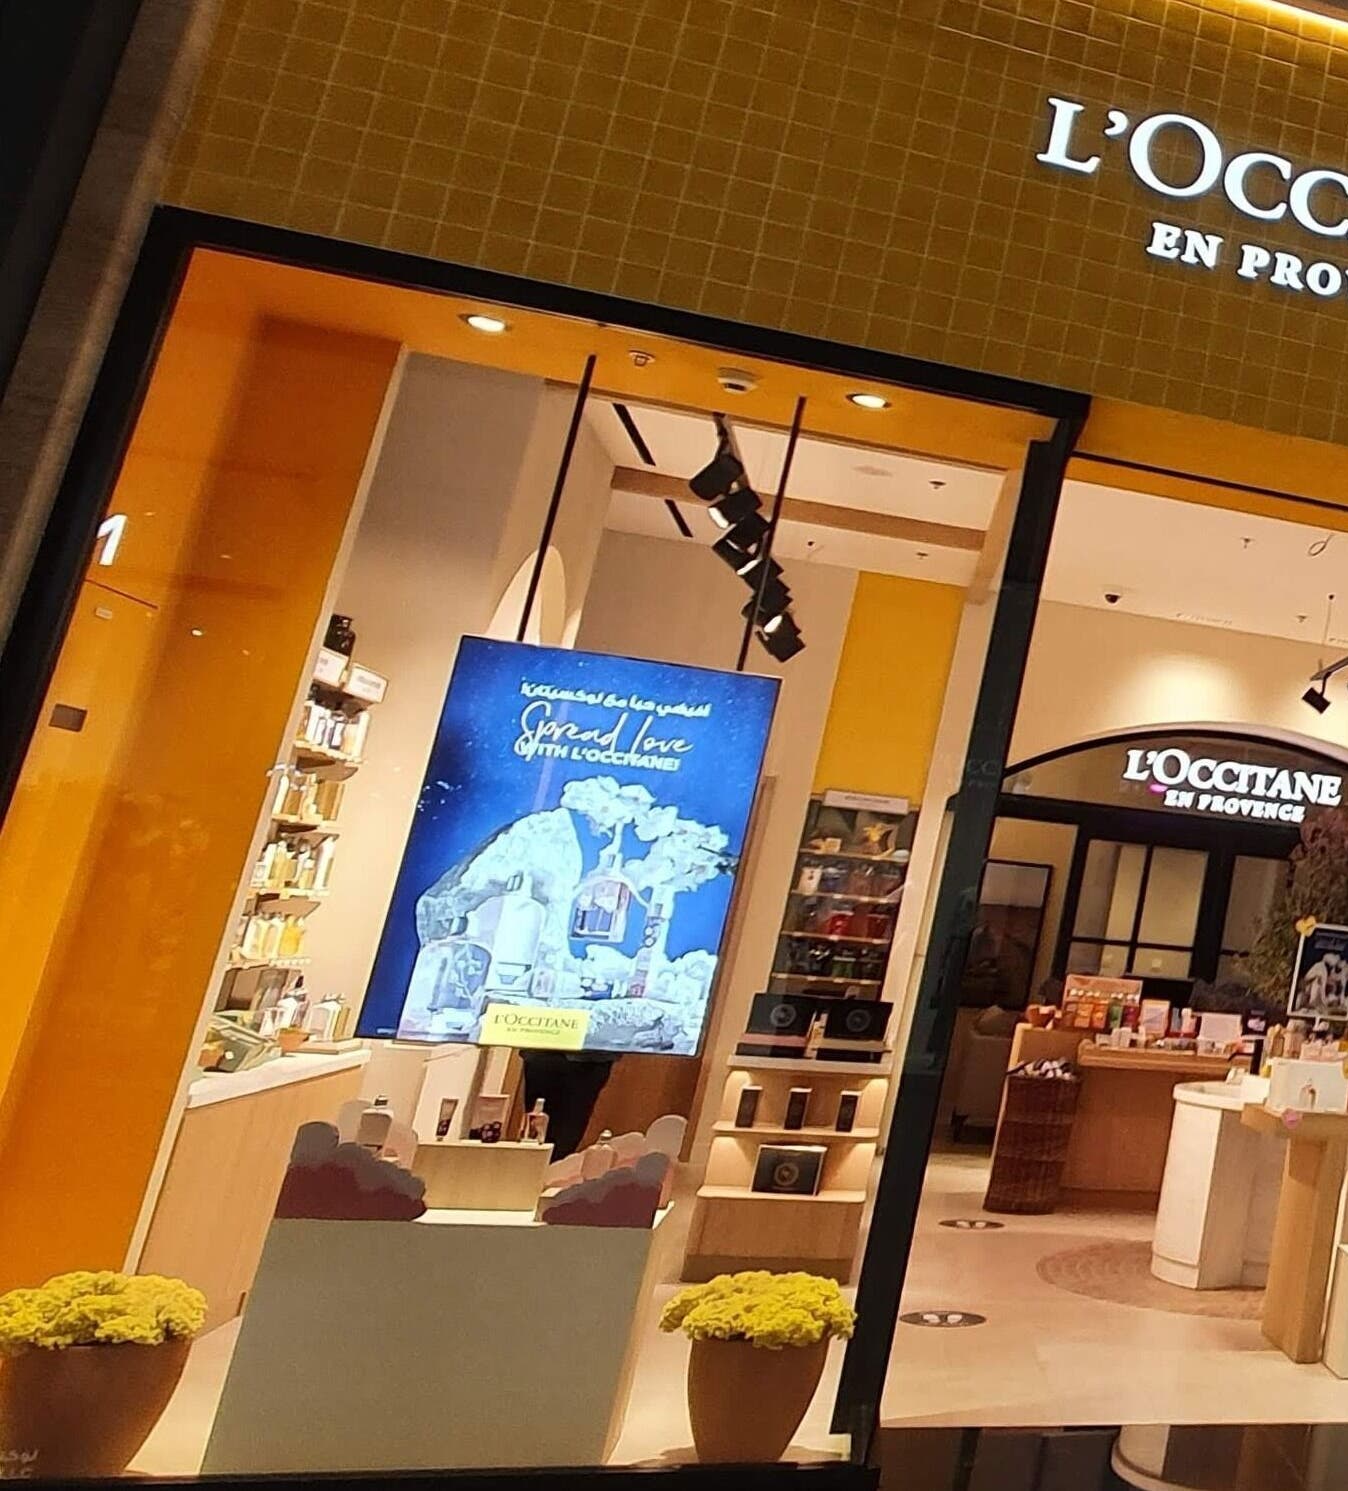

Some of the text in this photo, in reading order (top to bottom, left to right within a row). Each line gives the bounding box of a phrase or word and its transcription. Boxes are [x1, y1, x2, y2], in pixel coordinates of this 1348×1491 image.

[1145, 221, 1223, 270] EN
[514, 700, 694, 761] Spread love
[1122, 748, 1342, 806] L'OCCITANE
[1163, 789, 1306, 823] EN PROVENCE
